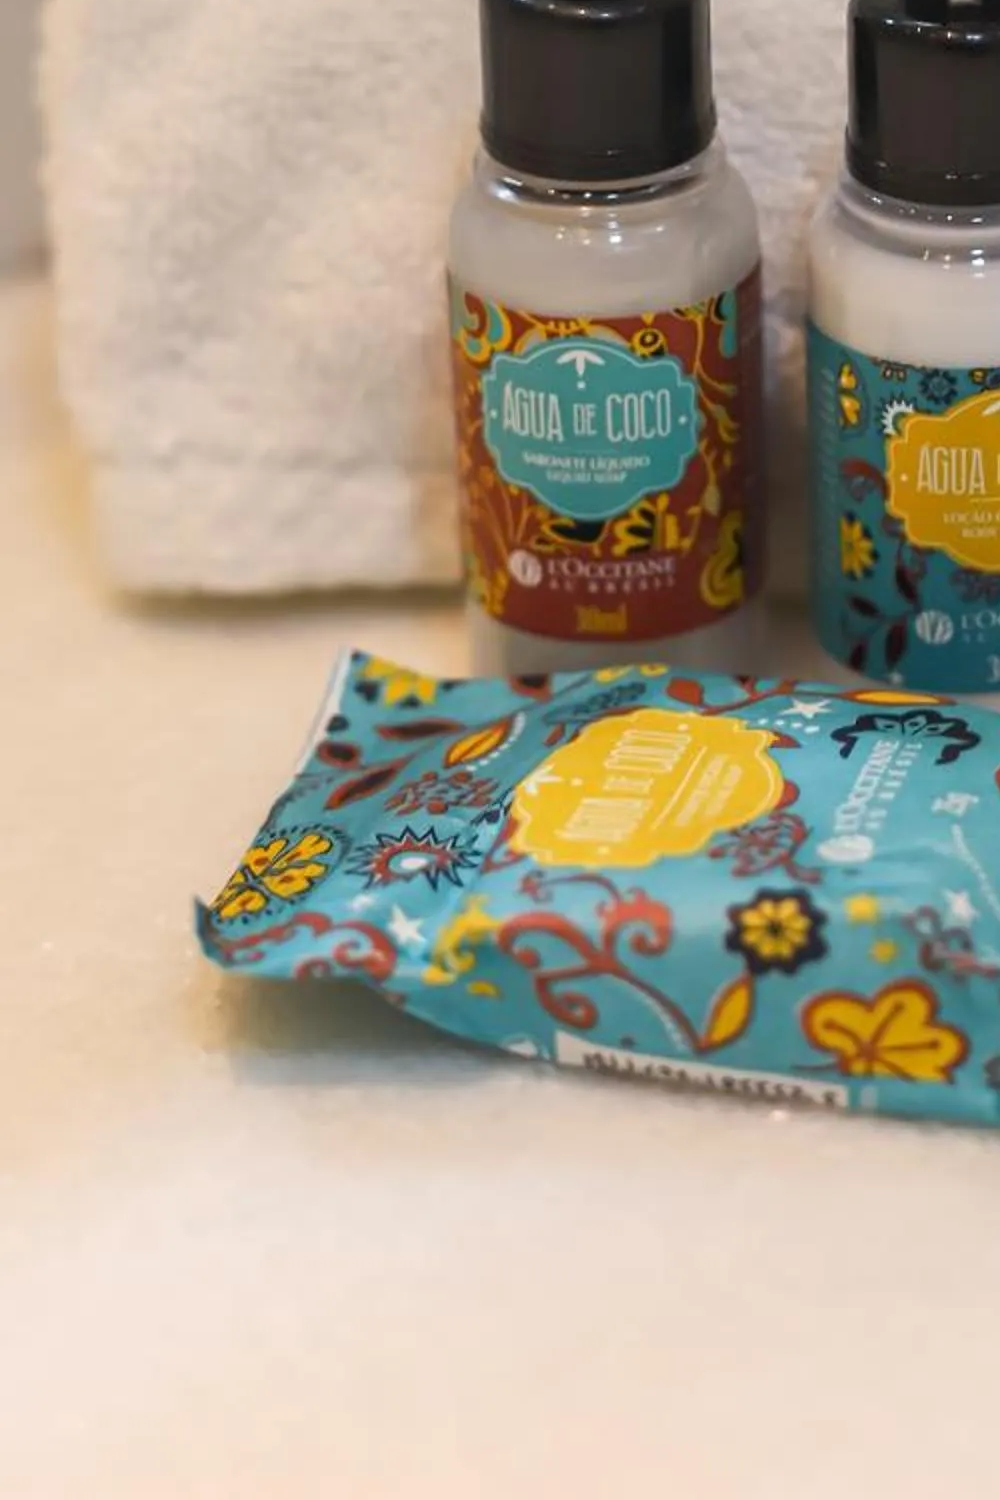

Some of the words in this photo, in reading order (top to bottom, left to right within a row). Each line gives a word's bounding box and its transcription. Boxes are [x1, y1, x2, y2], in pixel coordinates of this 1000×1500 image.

[503, 380, 564, 442] ÁGUA
[573, 402, 597, 436] DE
[606, 388, 672, 443] COCO
[916, 443, 986, 496] ÁGUA
